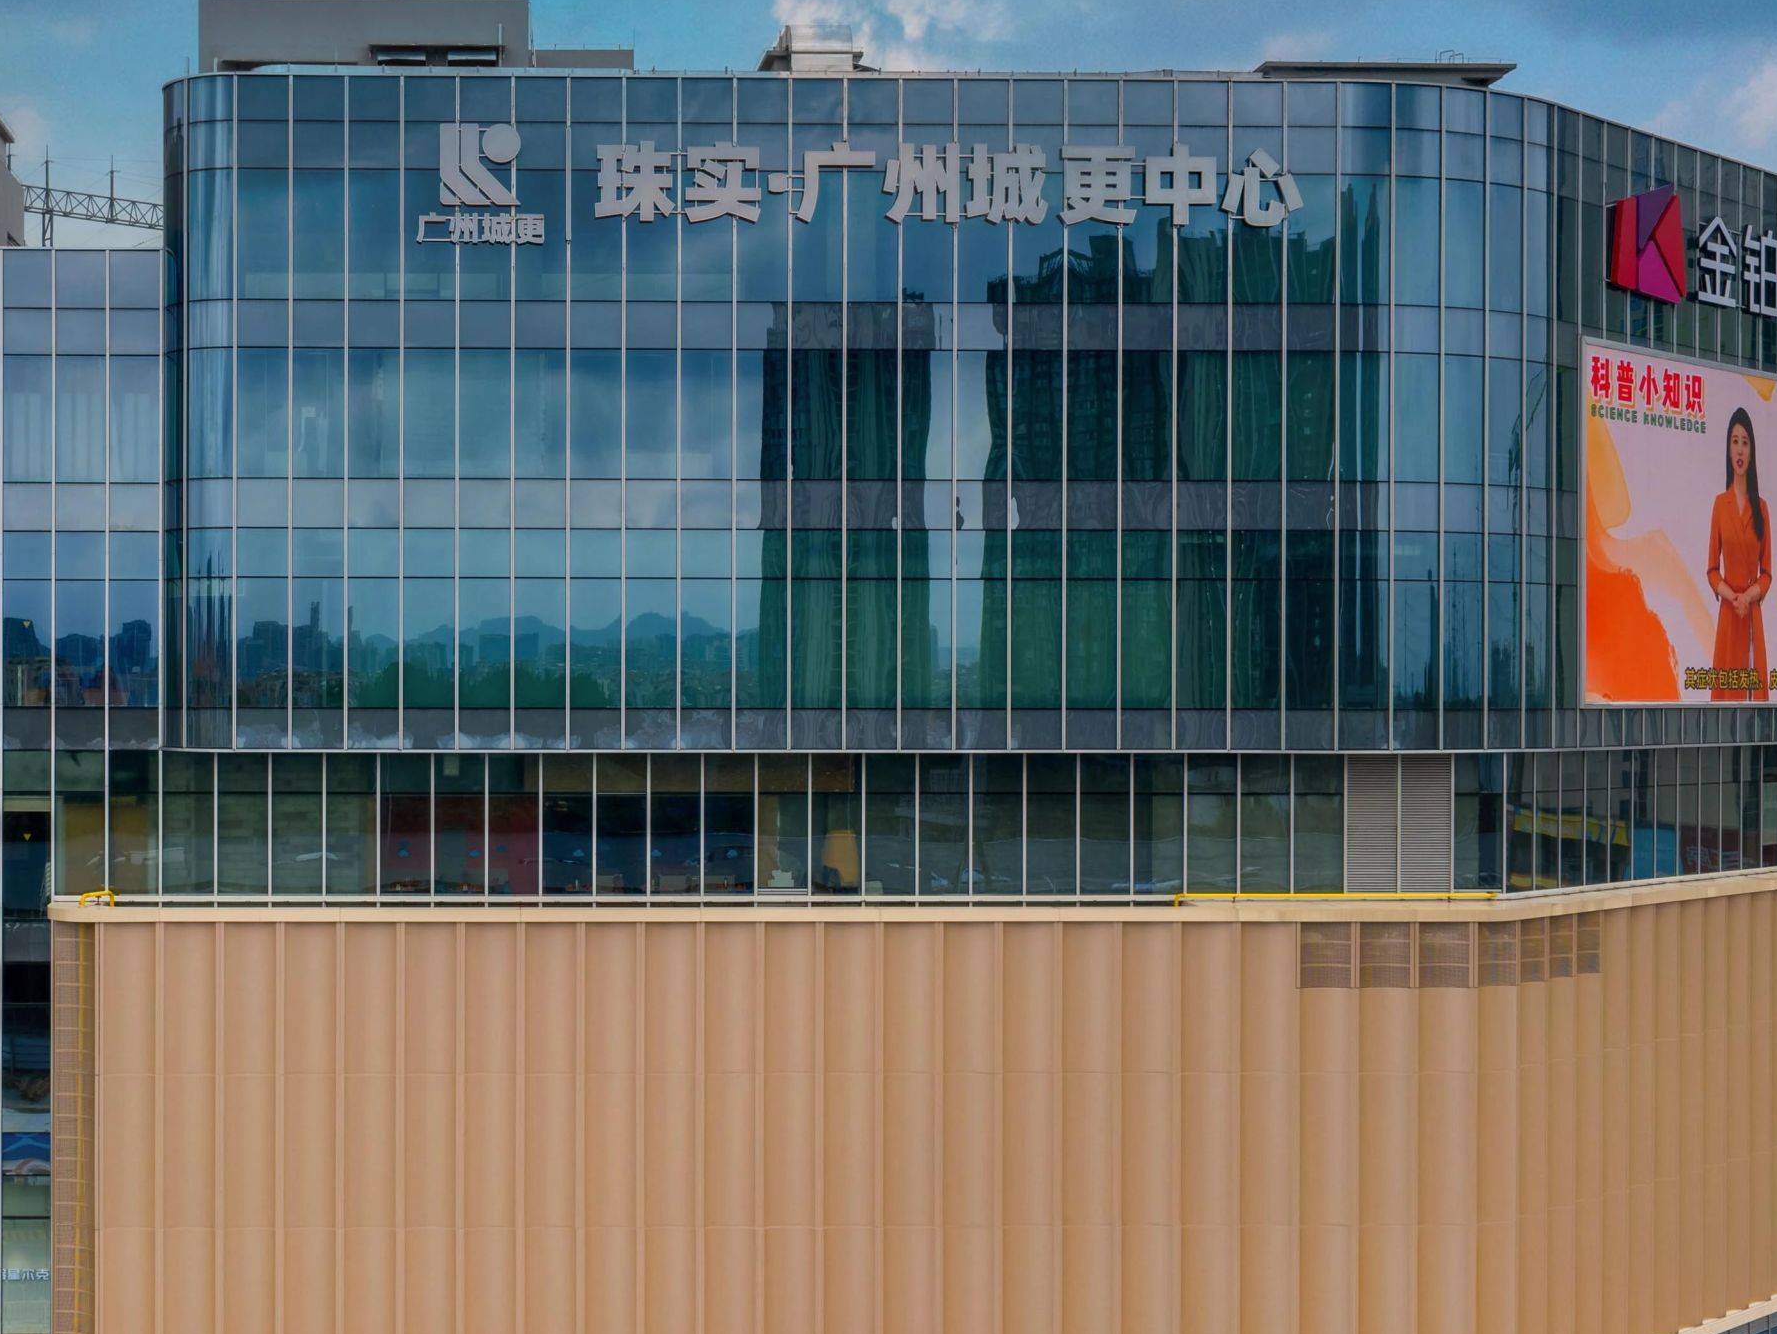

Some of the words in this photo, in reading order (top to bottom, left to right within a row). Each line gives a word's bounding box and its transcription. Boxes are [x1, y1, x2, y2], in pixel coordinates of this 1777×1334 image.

[594, 141, 1304, 227] 珠实·广州城更中心
[417, 212, 544, 244] 广州城更
[1591, 356, 1704, 415] 科普小知识
[1644, 411, 1706, 434] KNOWLEDGE
